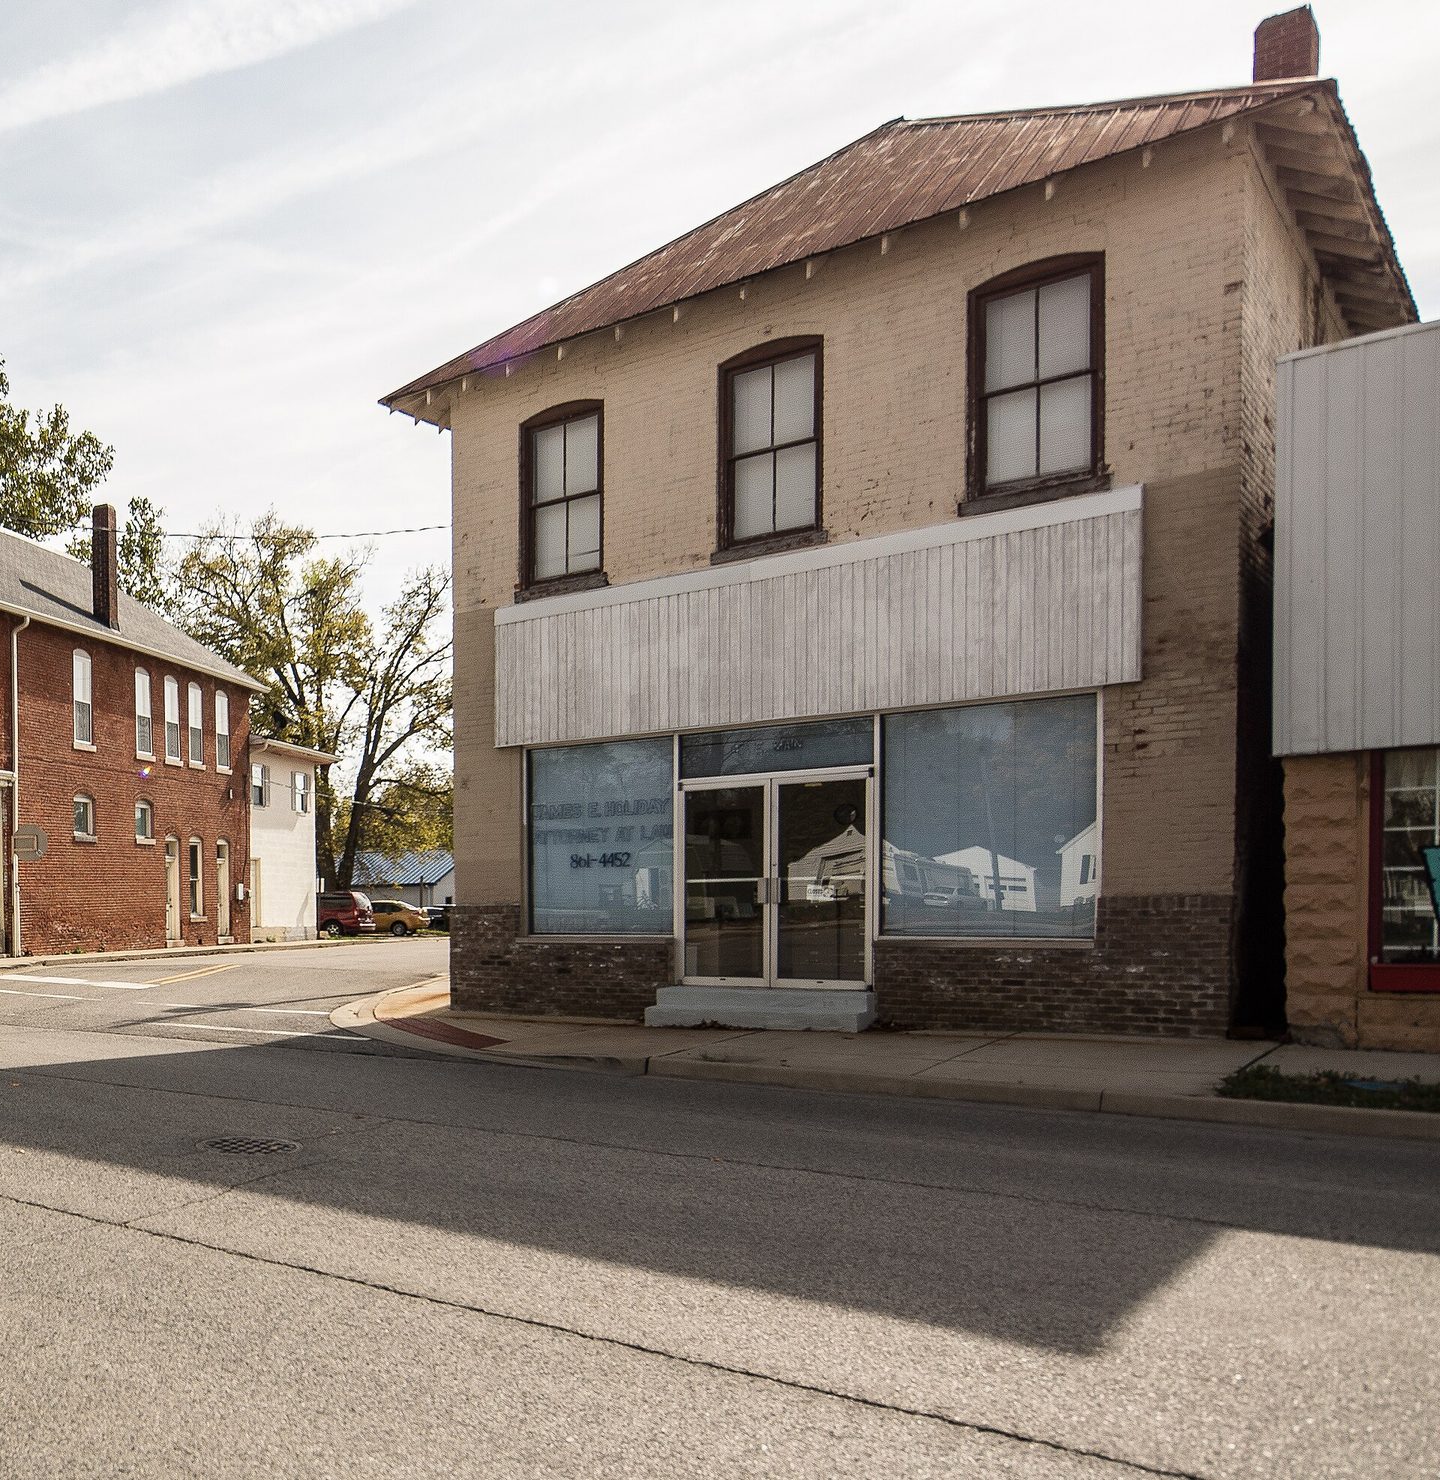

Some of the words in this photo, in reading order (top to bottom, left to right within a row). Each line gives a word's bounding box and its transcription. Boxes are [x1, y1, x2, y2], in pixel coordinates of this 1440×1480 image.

[605, 798, 670, 817] HOLIDAY
[615, 825, 635, 842] AT
[570, 852, 631, 869] 861-4452
